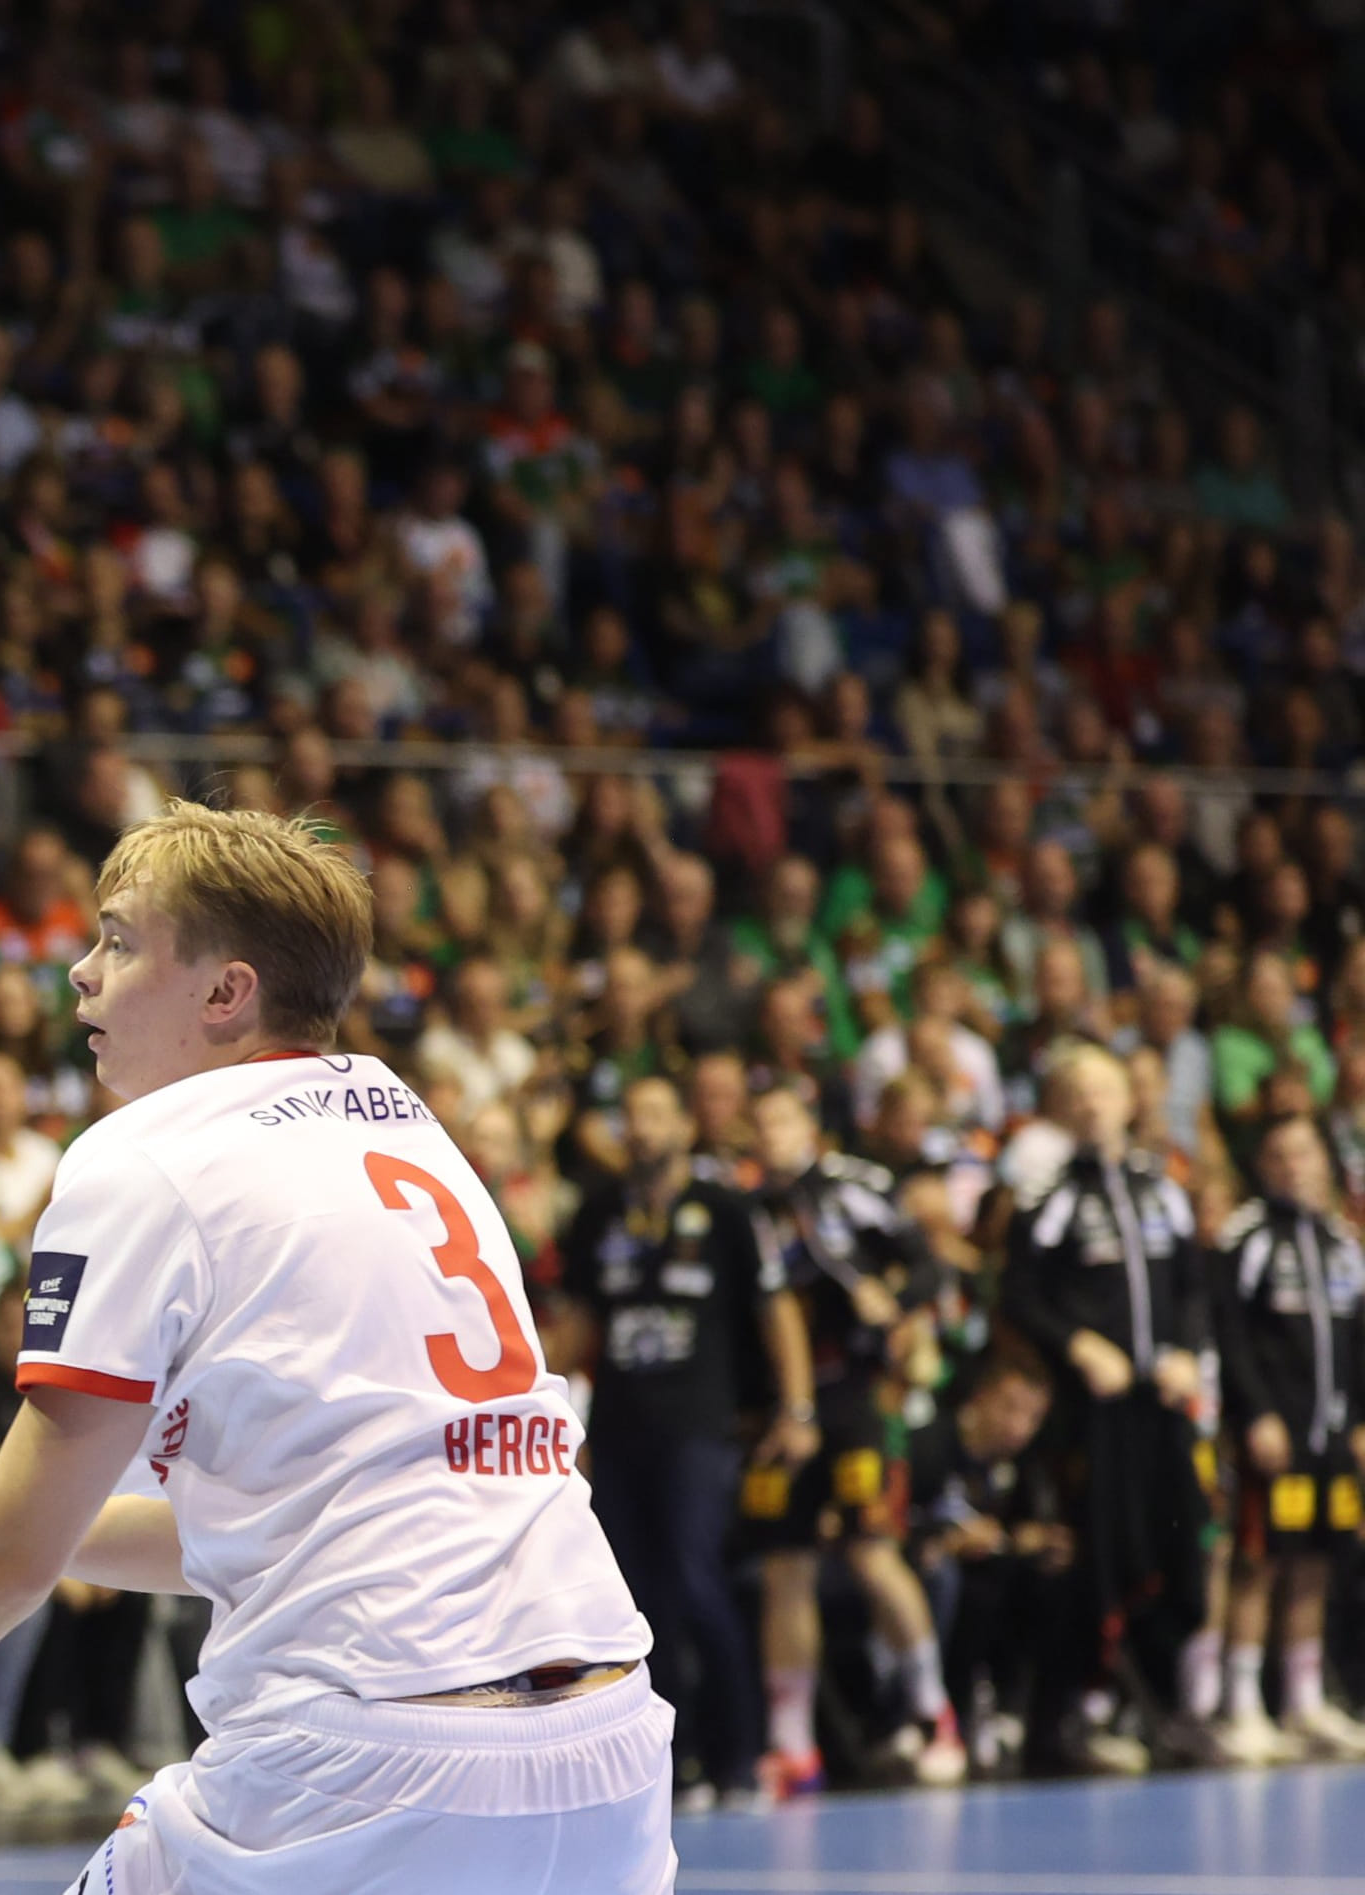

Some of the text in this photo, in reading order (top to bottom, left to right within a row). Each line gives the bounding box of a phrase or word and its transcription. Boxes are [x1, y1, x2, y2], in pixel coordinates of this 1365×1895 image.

[249, 1087, 439, 1126] SINKABER
[363, 1151, 536, 1403] 3
[444, 1413, 570, 1476] BERGE
